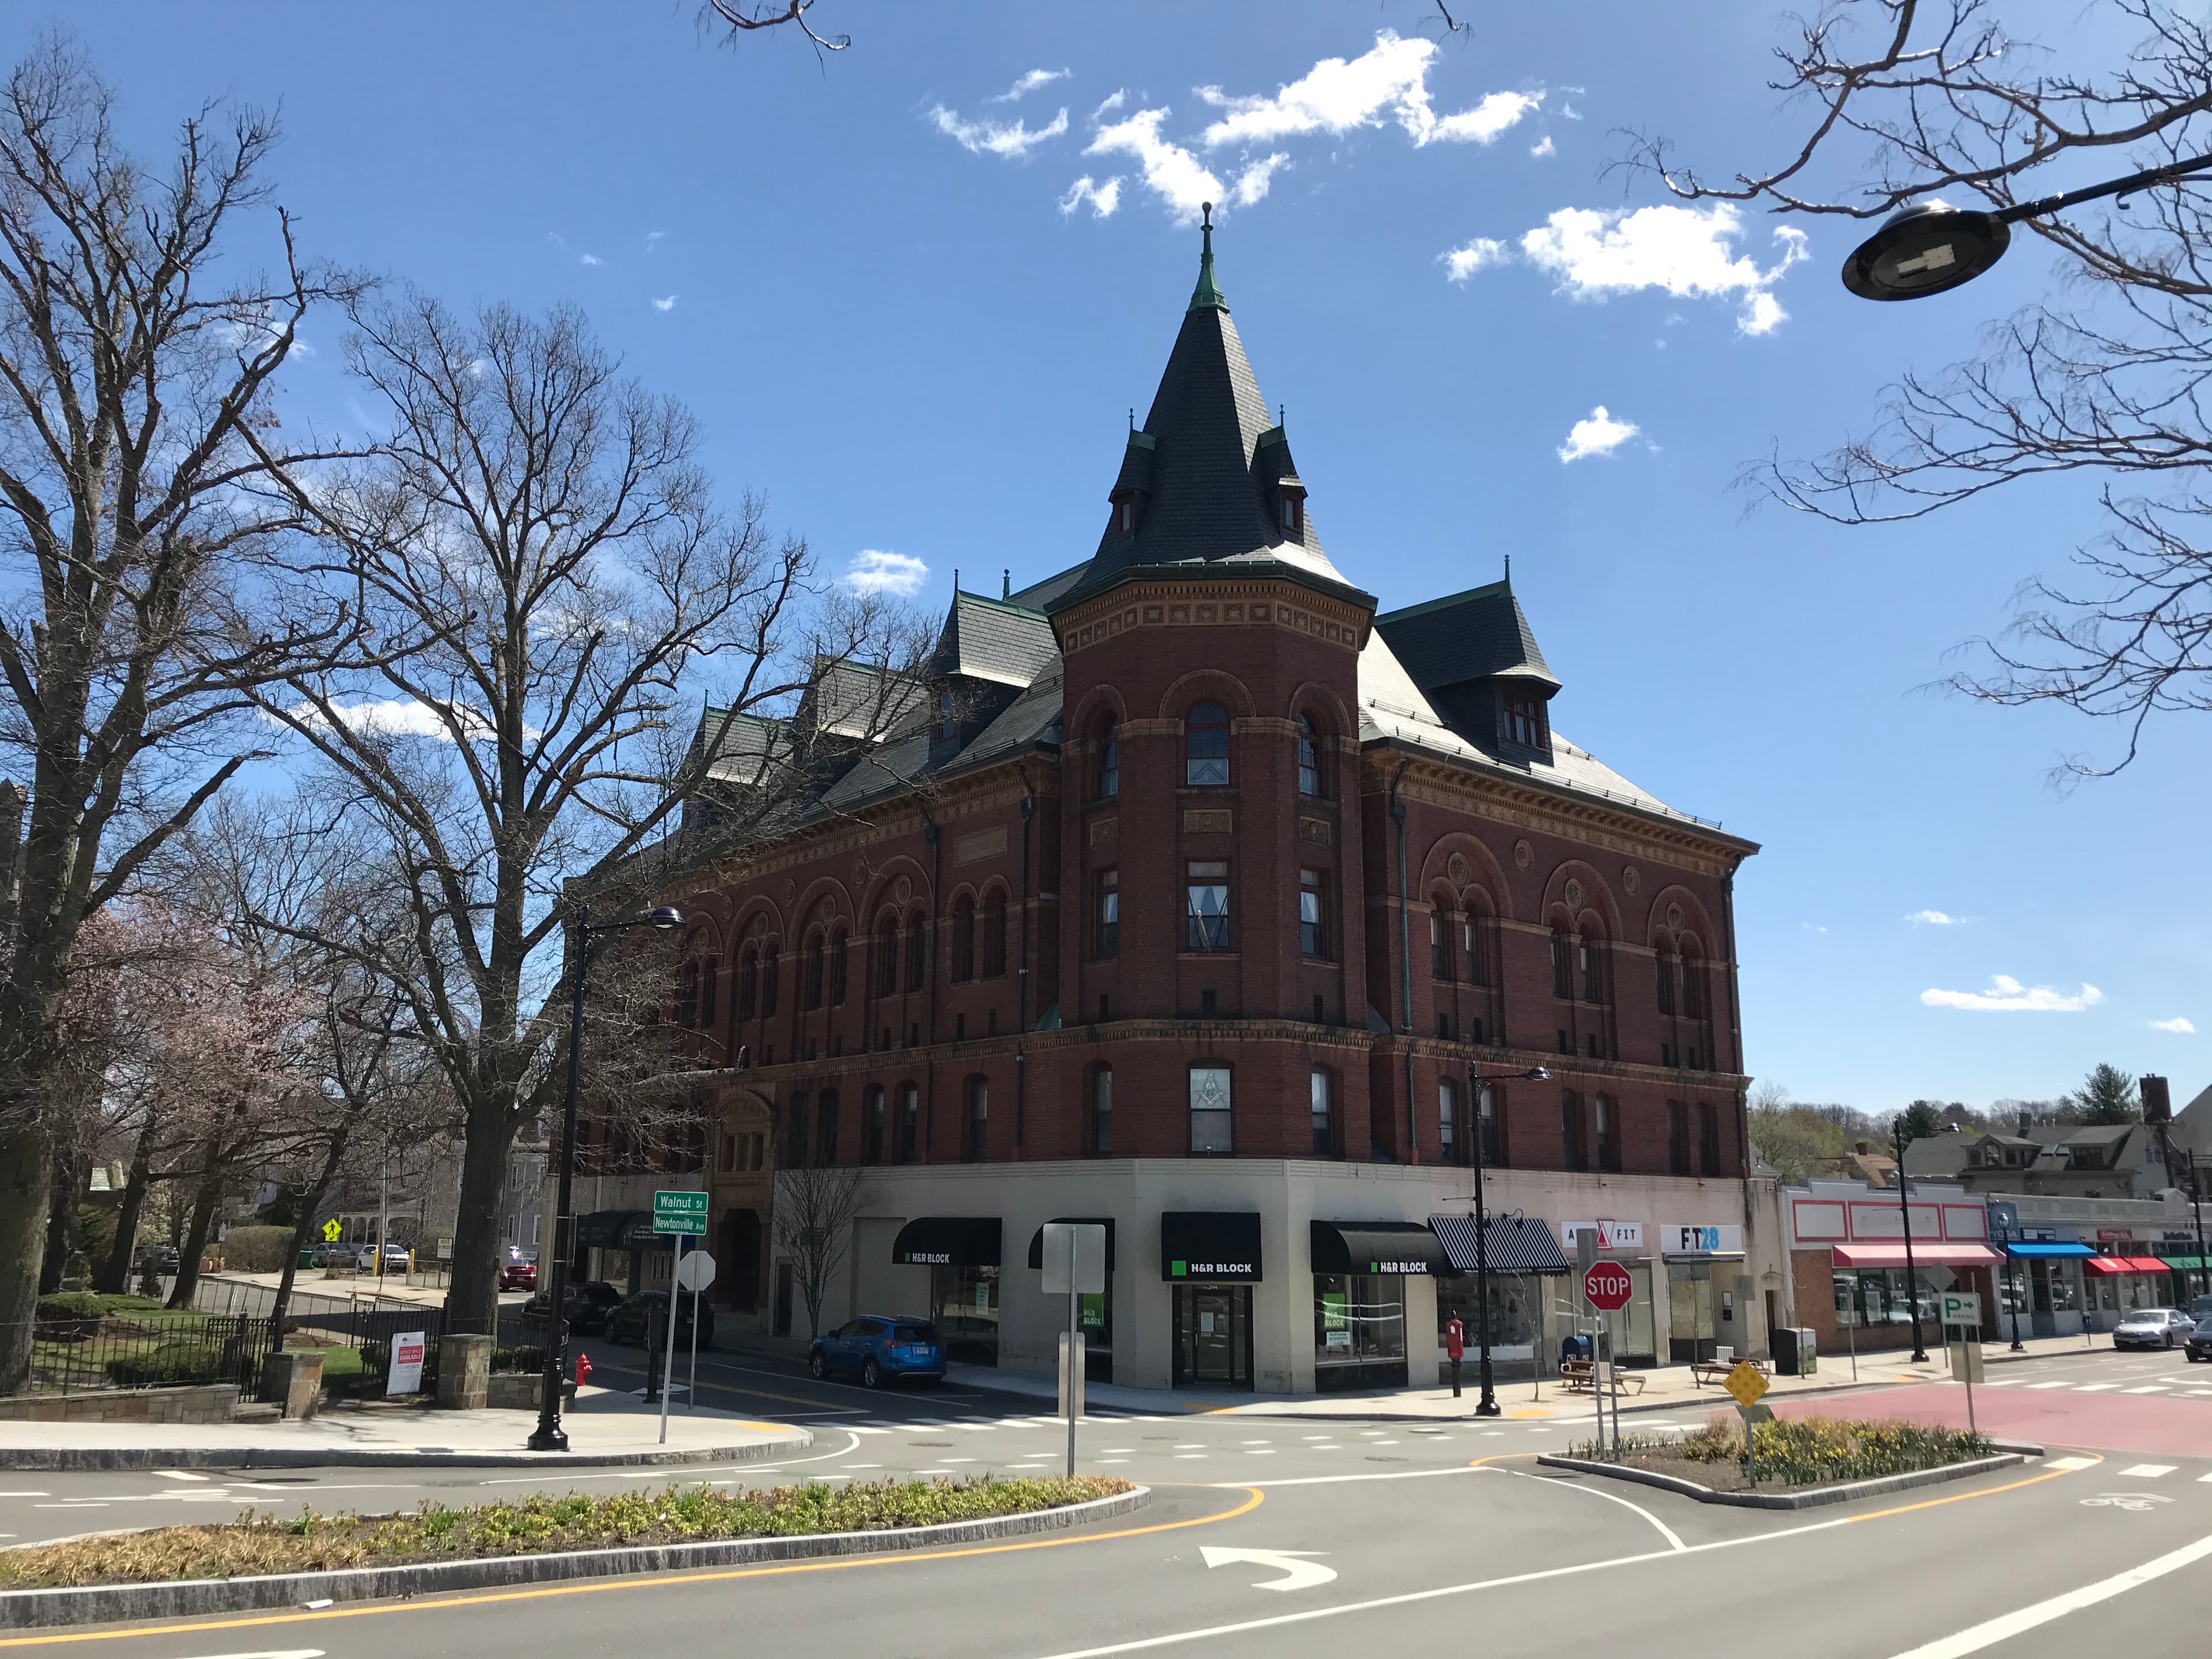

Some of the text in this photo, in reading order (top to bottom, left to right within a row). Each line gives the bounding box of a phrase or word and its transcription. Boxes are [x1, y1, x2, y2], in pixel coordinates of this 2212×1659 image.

[661, 1195, 702, 1209] Walnut St
[655, 1217, 704, 1230] Newtonville Ave
[1617, 1229, 1635, 1240] FIT
[1681, 1226, 1719, 1250] FT28
[912, 1253, 950, 1263] H&R BLOCK
[1191, 1263, 1252, 1272] H&R BLOCK
[1380, 1262, 1427, 1272] H&R BLOCK
[1588, 1277, 1629, 1296] STOP
[1084, 1309, 1096, 1317] H&R
[1084, 1317, 1101, 1325] BLOCK
[1325, 1319, 1344, 1327] BLOCK
